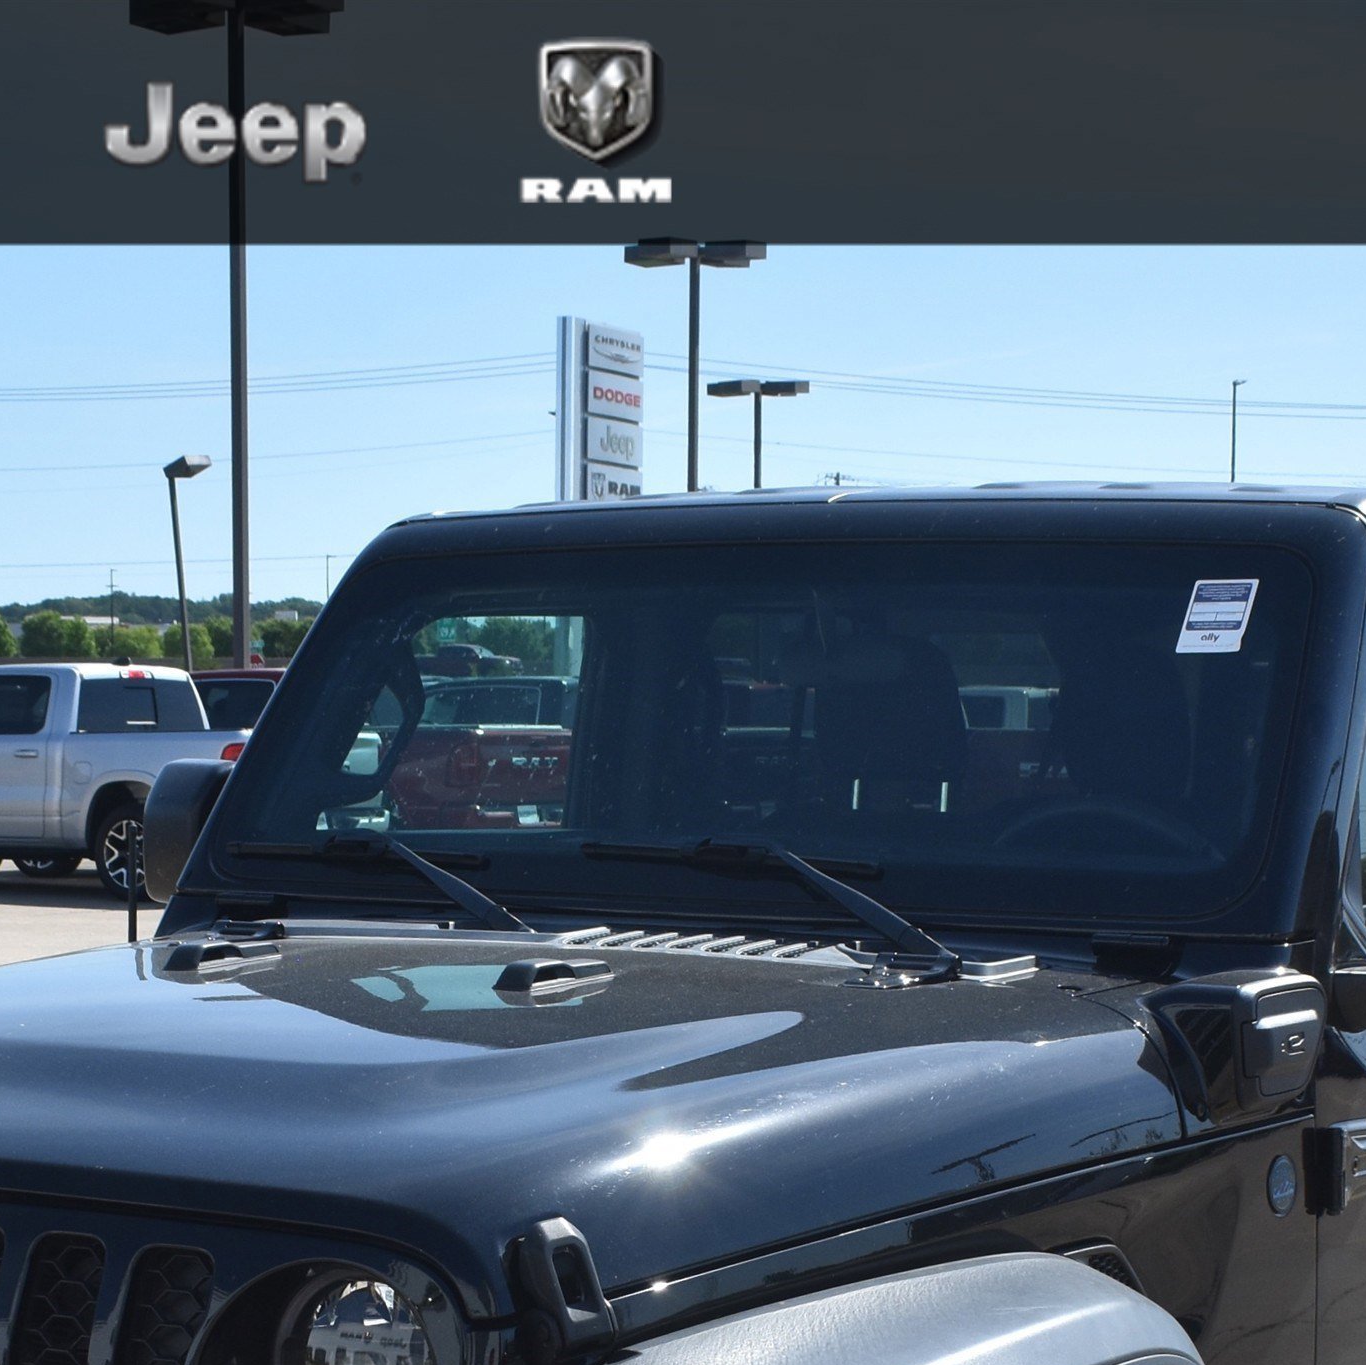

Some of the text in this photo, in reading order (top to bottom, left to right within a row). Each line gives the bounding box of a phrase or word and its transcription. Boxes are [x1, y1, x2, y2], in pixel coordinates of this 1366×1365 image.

[594, 334, 641, 352] CHRYSLER
[593, 386, 641, 408] DODGE
[600, 425, 635, 460] Jeep
[1200, 632, 1221, 643] ally
